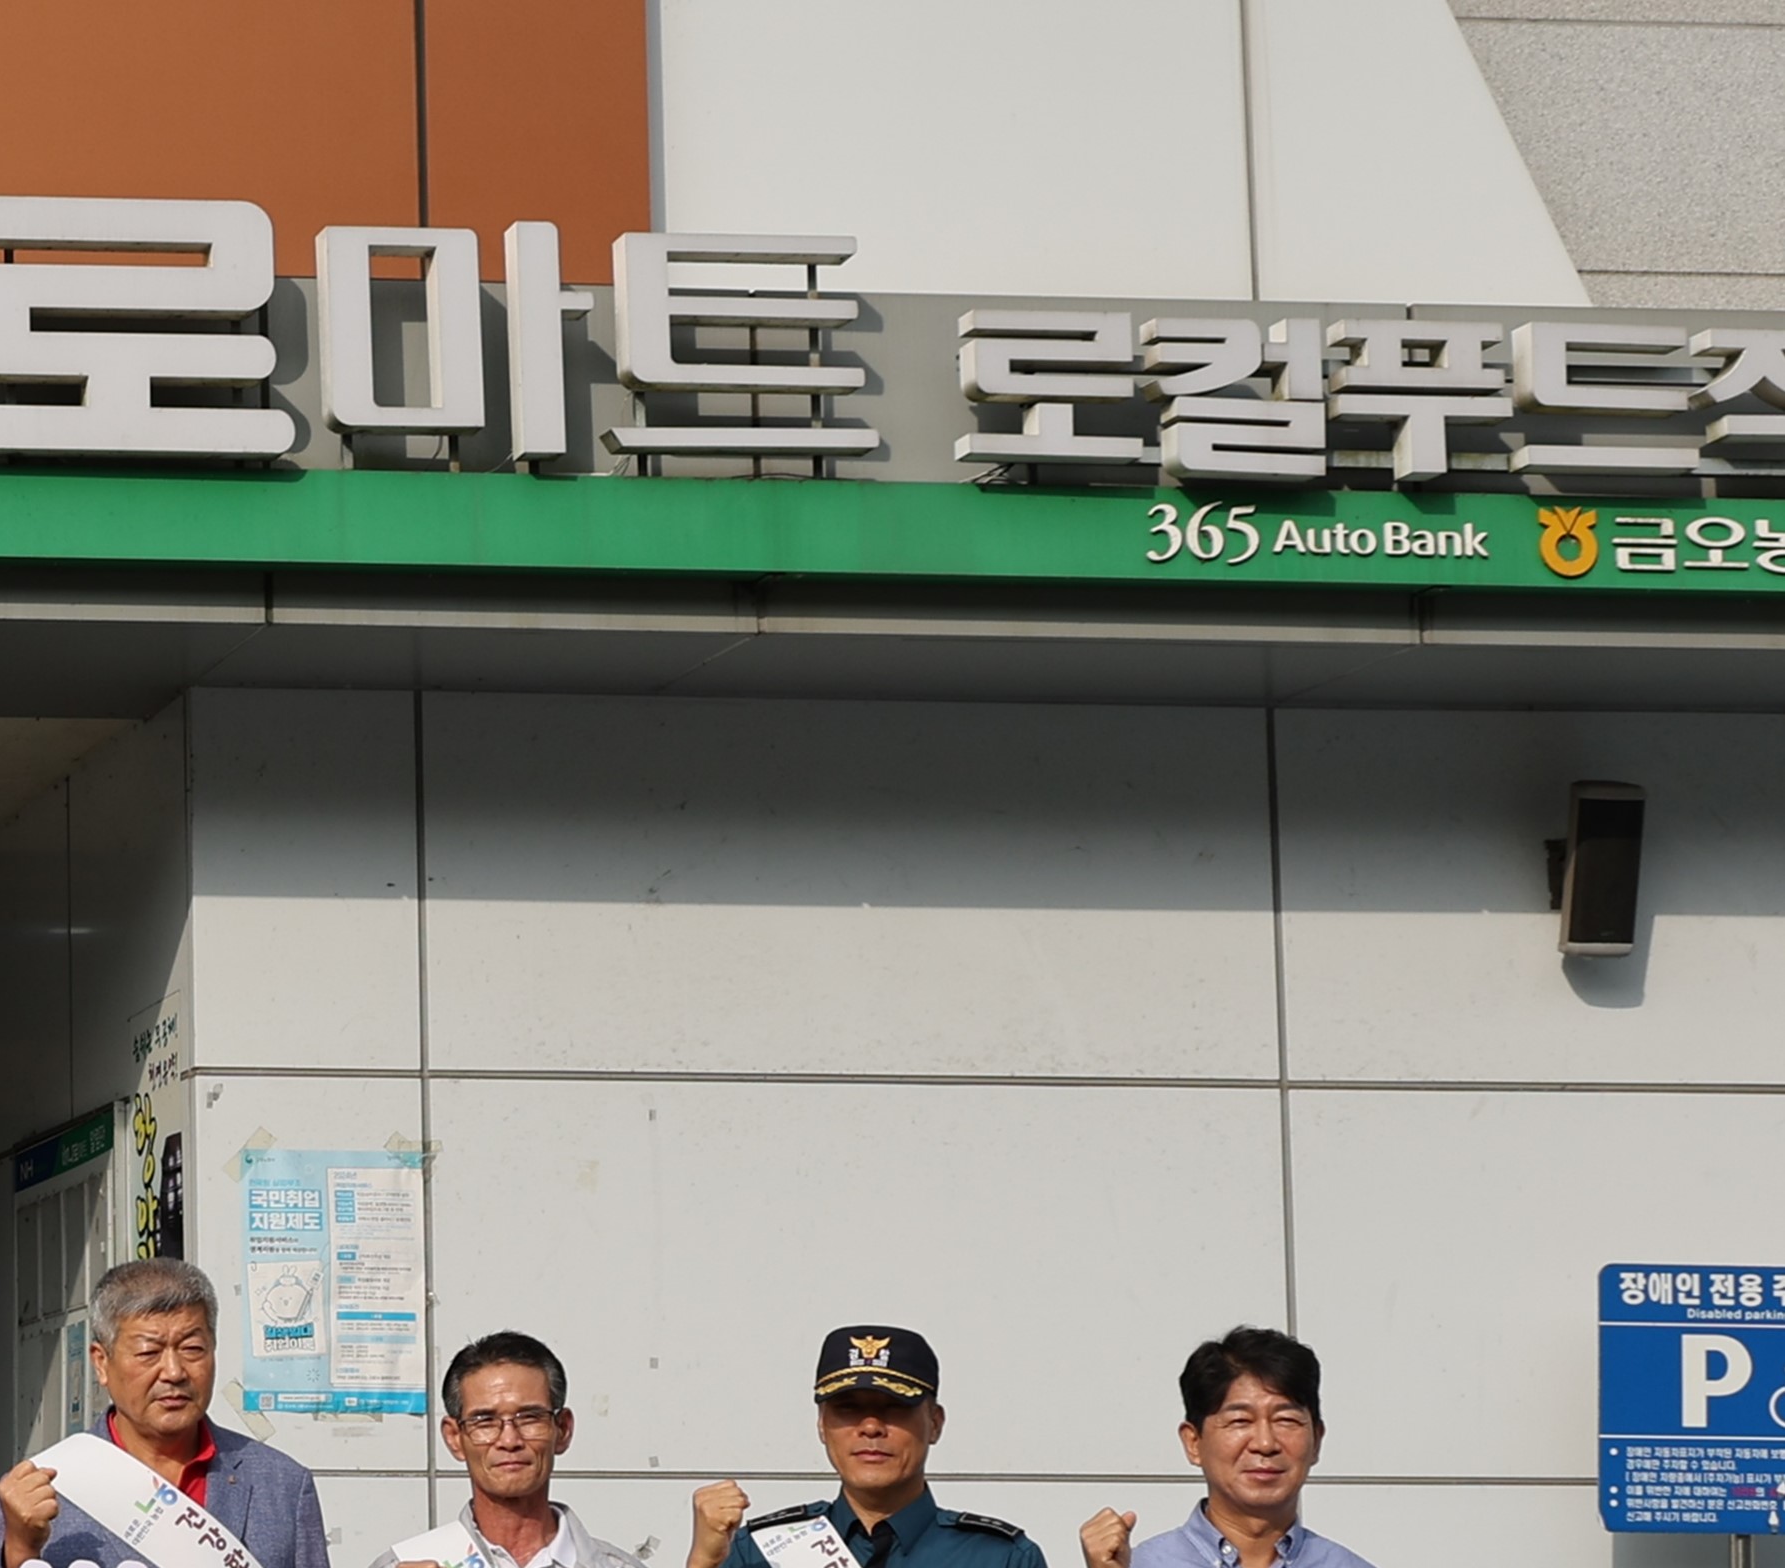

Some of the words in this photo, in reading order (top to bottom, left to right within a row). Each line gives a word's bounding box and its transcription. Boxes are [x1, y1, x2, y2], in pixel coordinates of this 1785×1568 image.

[1146, 501, 1259, 565] 365
[1273, 516, 1377, 557] Auto
[1383, 519, 1489, 559] Bank
[251, 1190, 319, 1208] 국민취업
[251, 1212, 321, 1230] 지원제도
[1619, 1272, 1701, 1306] 장애인
[1709, 1274, 1763, 1307] 전용
[1687, 1308, 1742, 1320] Disabled
[1681, 1333, 1753, 1428] P
